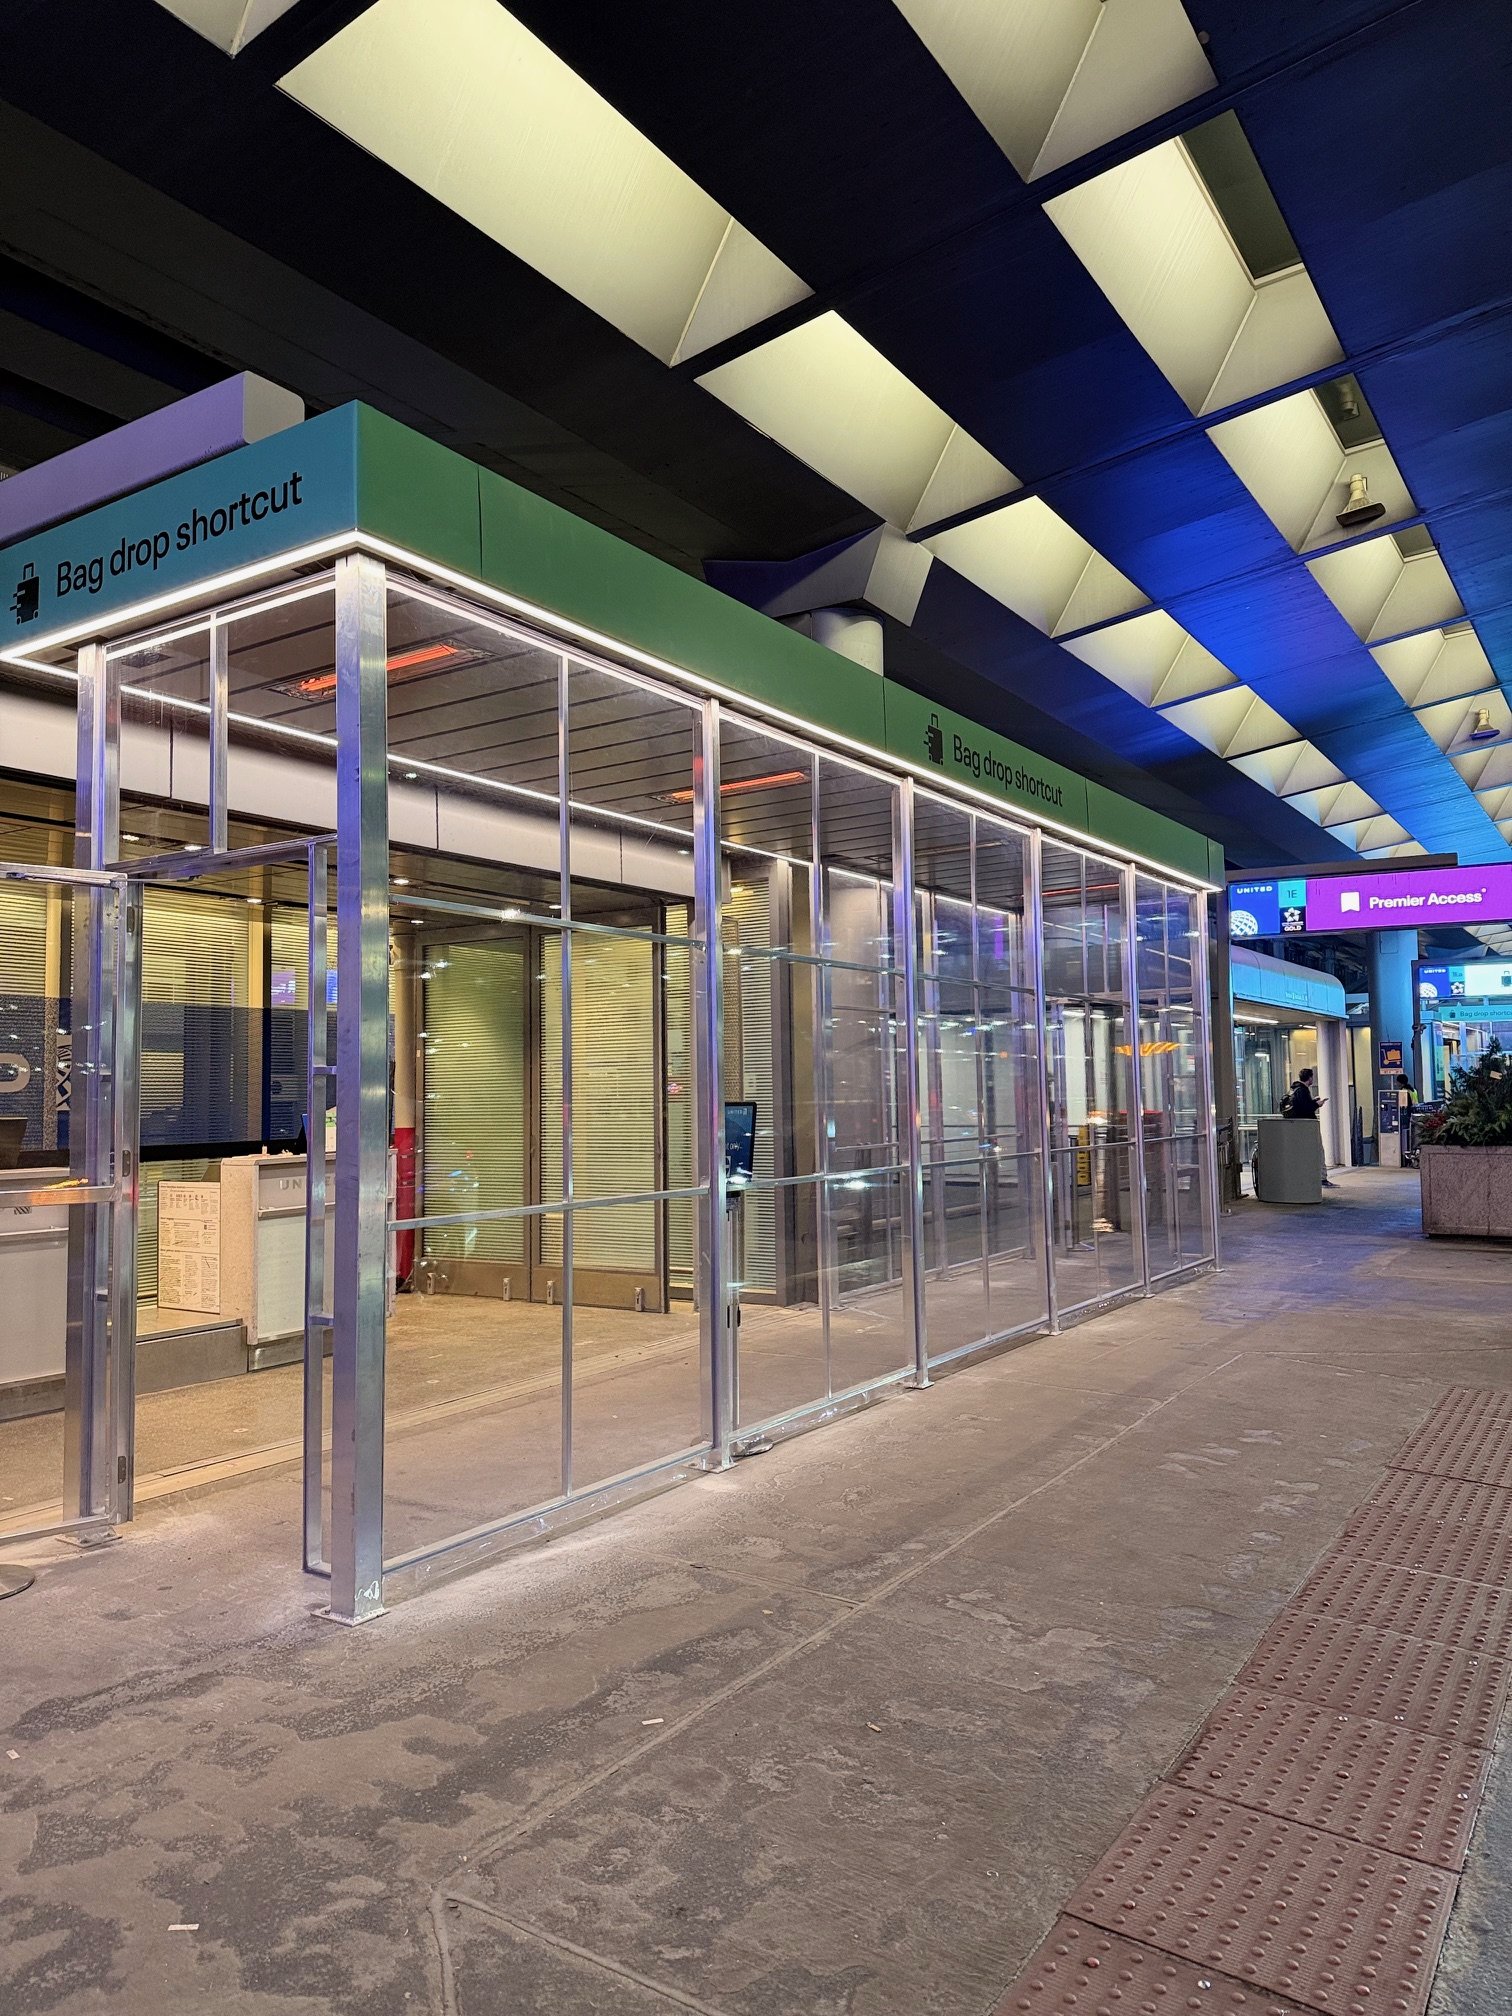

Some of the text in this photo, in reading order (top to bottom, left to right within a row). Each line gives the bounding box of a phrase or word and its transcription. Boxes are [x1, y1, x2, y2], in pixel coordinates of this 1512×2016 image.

[56, 471, 303, 597] Bag drop shortcut
[953, 734, 1063, 807] Bag drop shortcut
[1236, 885, 1273, 894] UNITED
[1287, 889, 1297, 899] 1E
[1369, 892, 1483, 909] Premier Access
[1460, 1010, 1472, 1018] Bag
